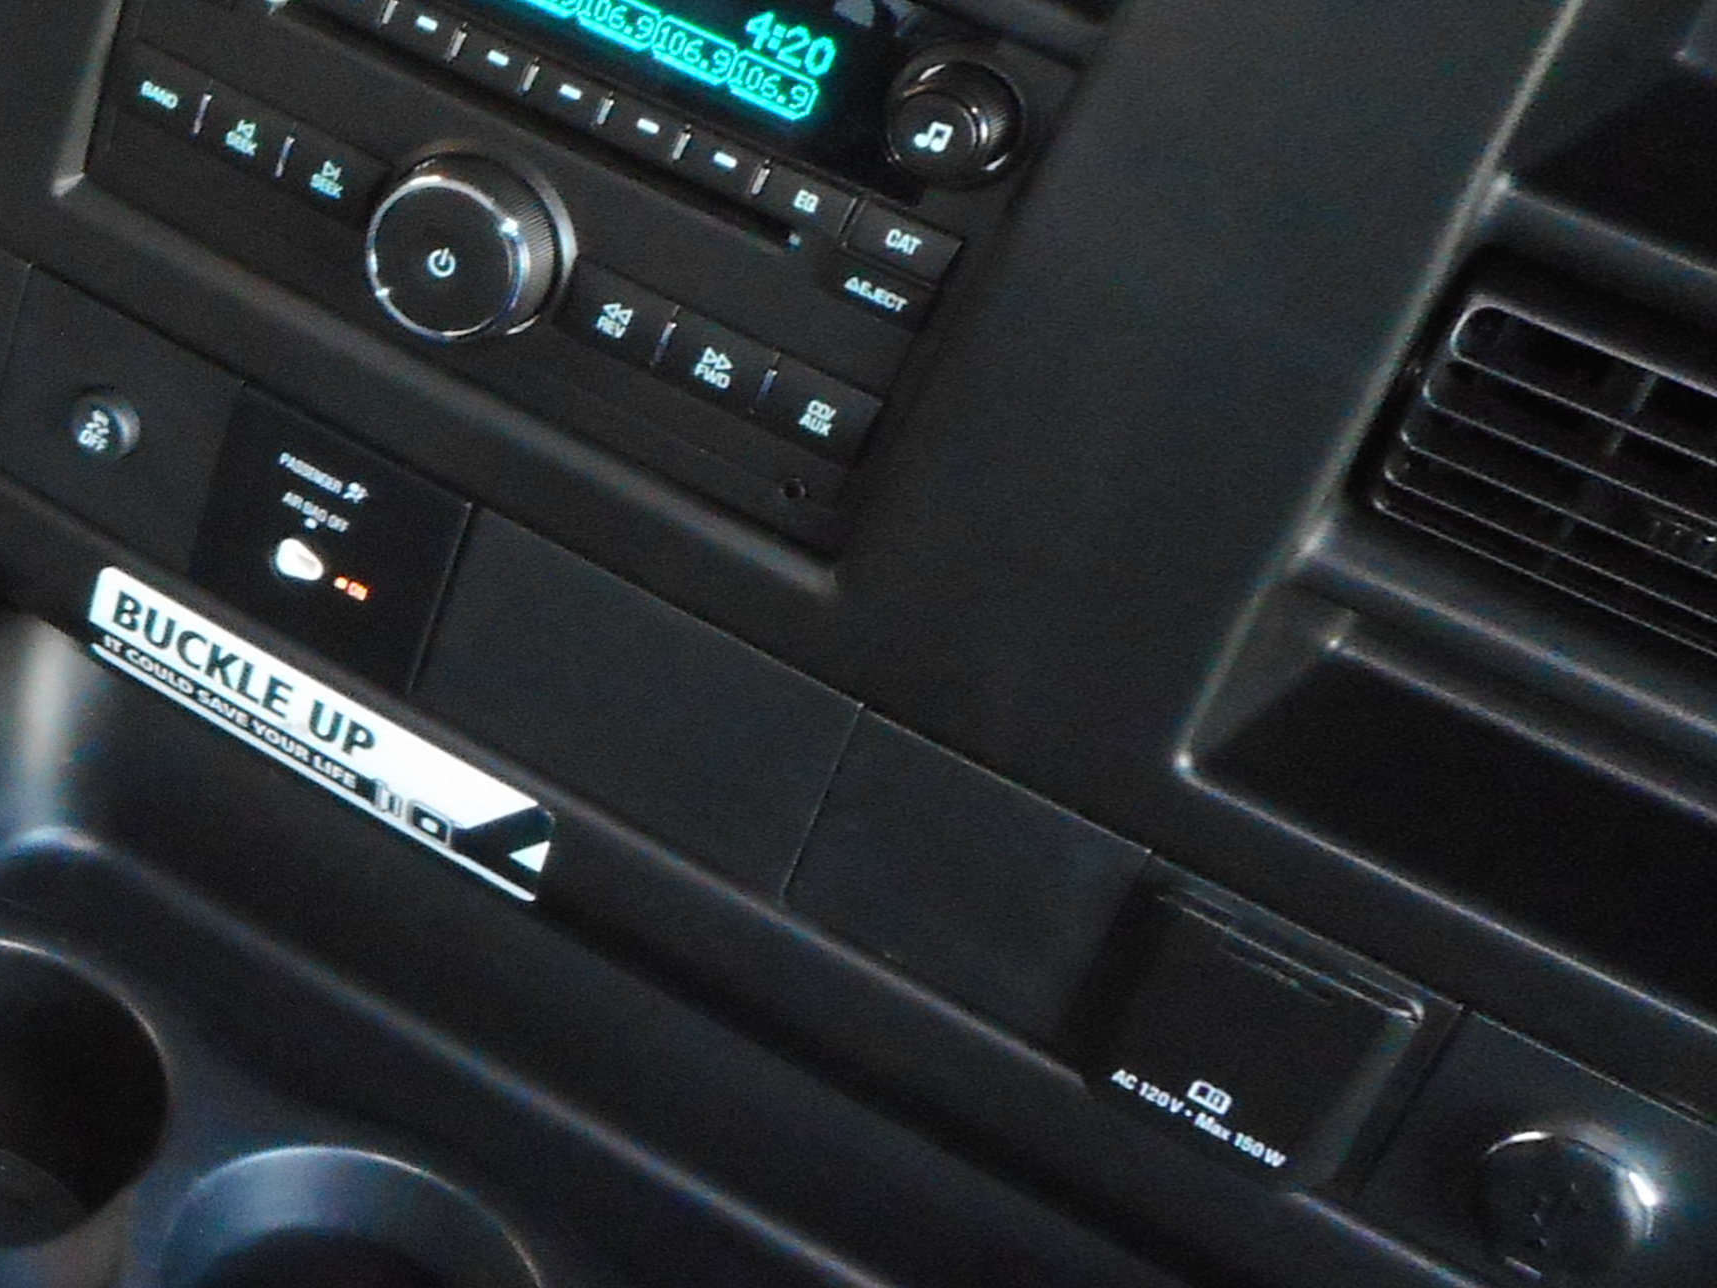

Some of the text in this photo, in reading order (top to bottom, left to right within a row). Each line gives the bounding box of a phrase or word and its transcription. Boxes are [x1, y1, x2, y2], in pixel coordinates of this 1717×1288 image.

[746, 12, 836, 77] 4:20
[652, 24, 732, 76] 106.9
[730, 61, 810, 110] 106.9
[140, 79, 179, 109] BAND
[793, 189, 820, 213] EQ
[884, 228, 923, 256] CAT
[859, 281, 908, 312] EJECT
[595, 314, 627, 339] REV
[694, 364, 731, 390] FWD
[77, 428, 108, 452] OFF
[798, 414, 833, 437] AUX
[113, 590, 376, 756] BUCKLE UP
[103, 634, 357, 789] IT COULD SAVE YOUR LIFE
[1111, 1069, 1138, 1090] AC
[1194, 1112, 1233, 1141] Max
